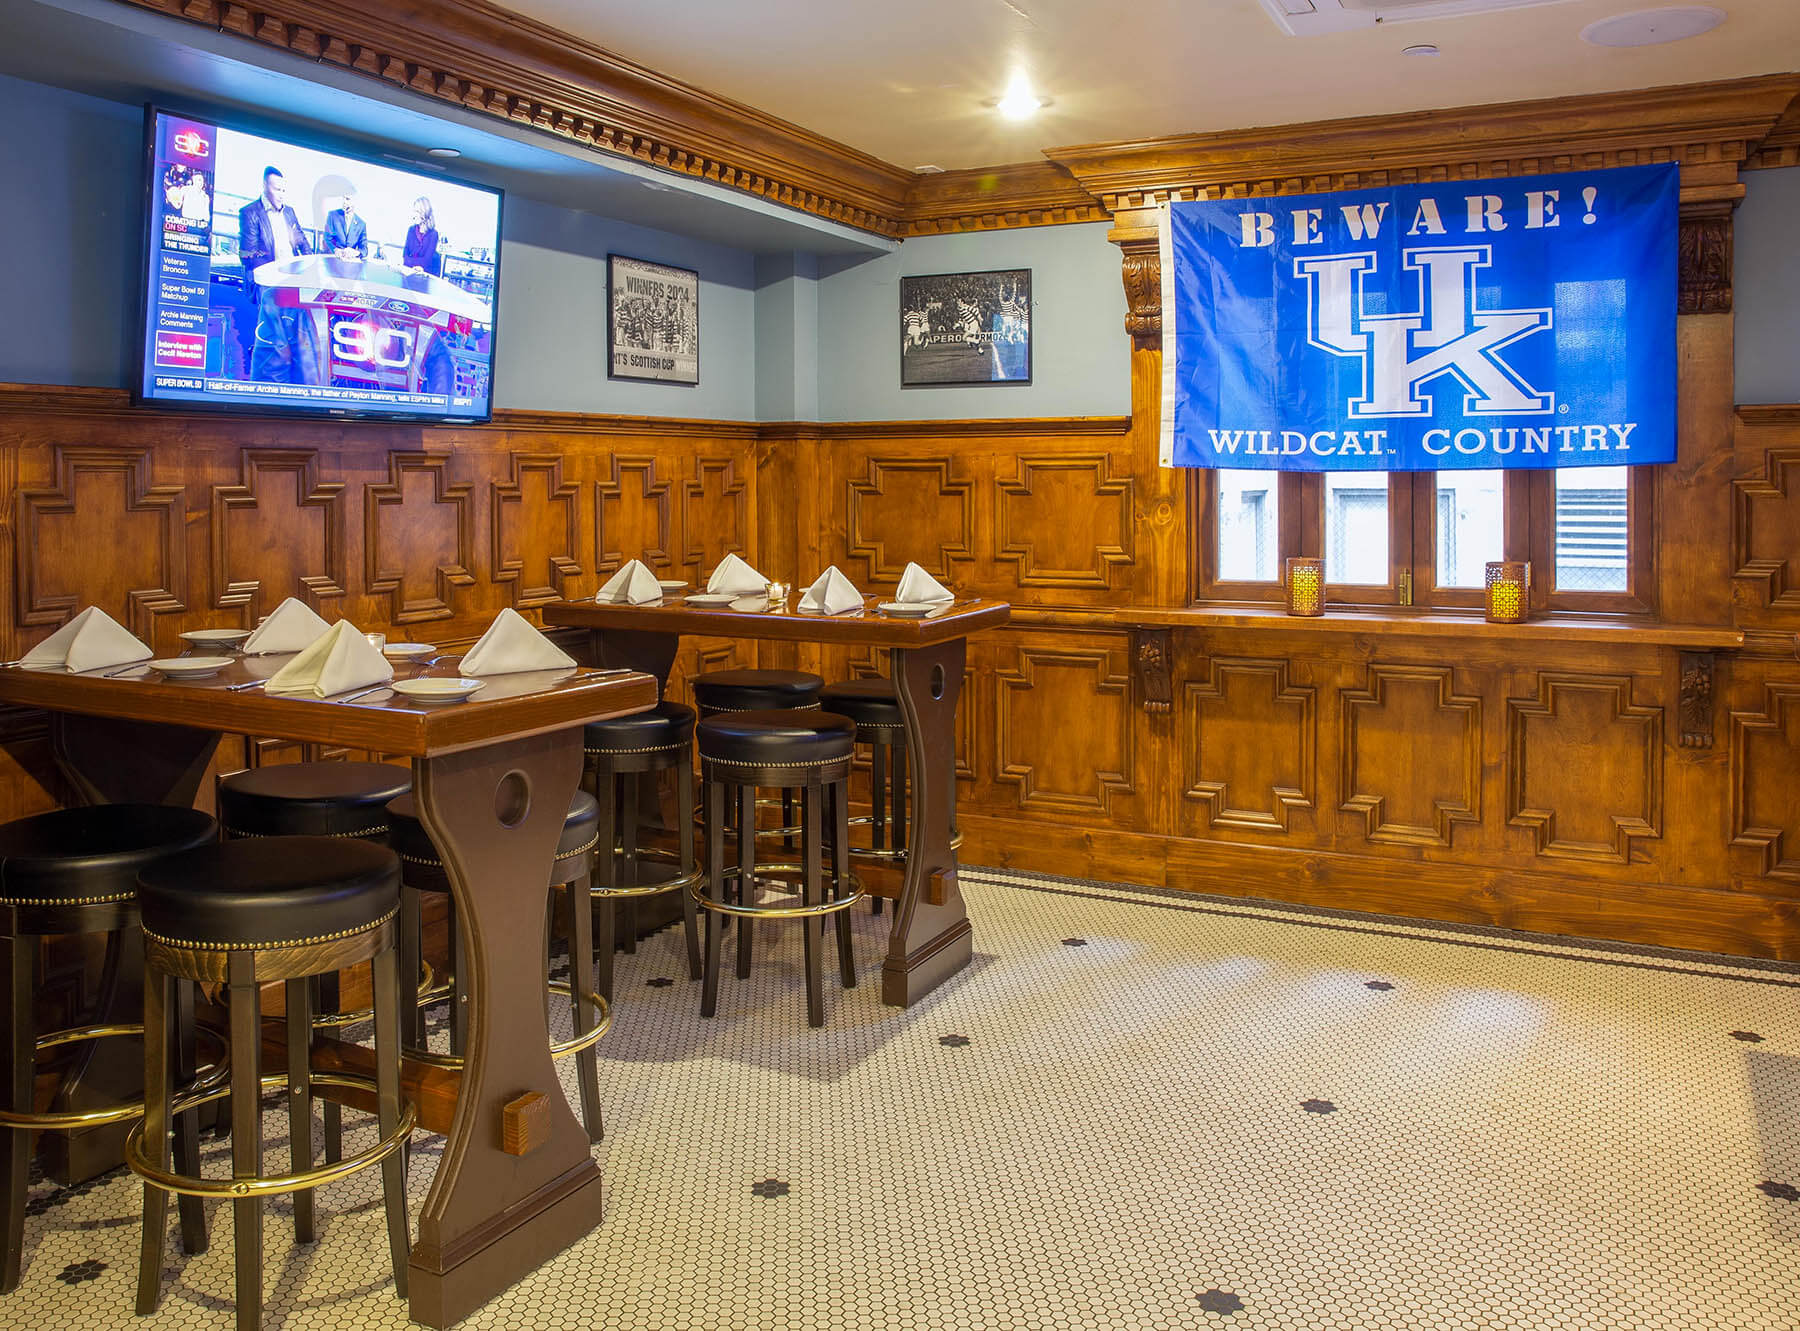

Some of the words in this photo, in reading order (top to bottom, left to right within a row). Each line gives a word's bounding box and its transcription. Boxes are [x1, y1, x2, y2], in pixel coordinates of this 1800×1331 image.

[164, 222, 176, 231] ON
[176, 224, 187, 233] SC
[197, 219, 208, 229] UP
[164, 240, 178, 249] THE
[178, 242, 209, 254] THUNDER
[163, 256, 187, 267] Veteran
[162, 264, 189, 275] Broncos
[162, 283, 181, 293] Super
[181, 285, 196, 294] Bowl
[197, 286, 206, 296] 50
[161, 291, 189, 303] Matchup
[160, 310, 179, 319] Archie
[179, 312, 204, 324] Manning
[159, 318, 194, 329] Comments
[1293, 244, 1554, 420] UK
[158, 340, 188, 351] Interview
[333, 320, 411, 368] SC
[630, 354, 661, 370] SCOTTISH
[156, 378, 177, 388] SUPER
[177, 379, 194, 389] BOWL
[208, 381, 256, 393] Hall-of-Famer
[256, 384, 279, 394] Archie
[1422, 423, 1637, 455] COUNTRY
